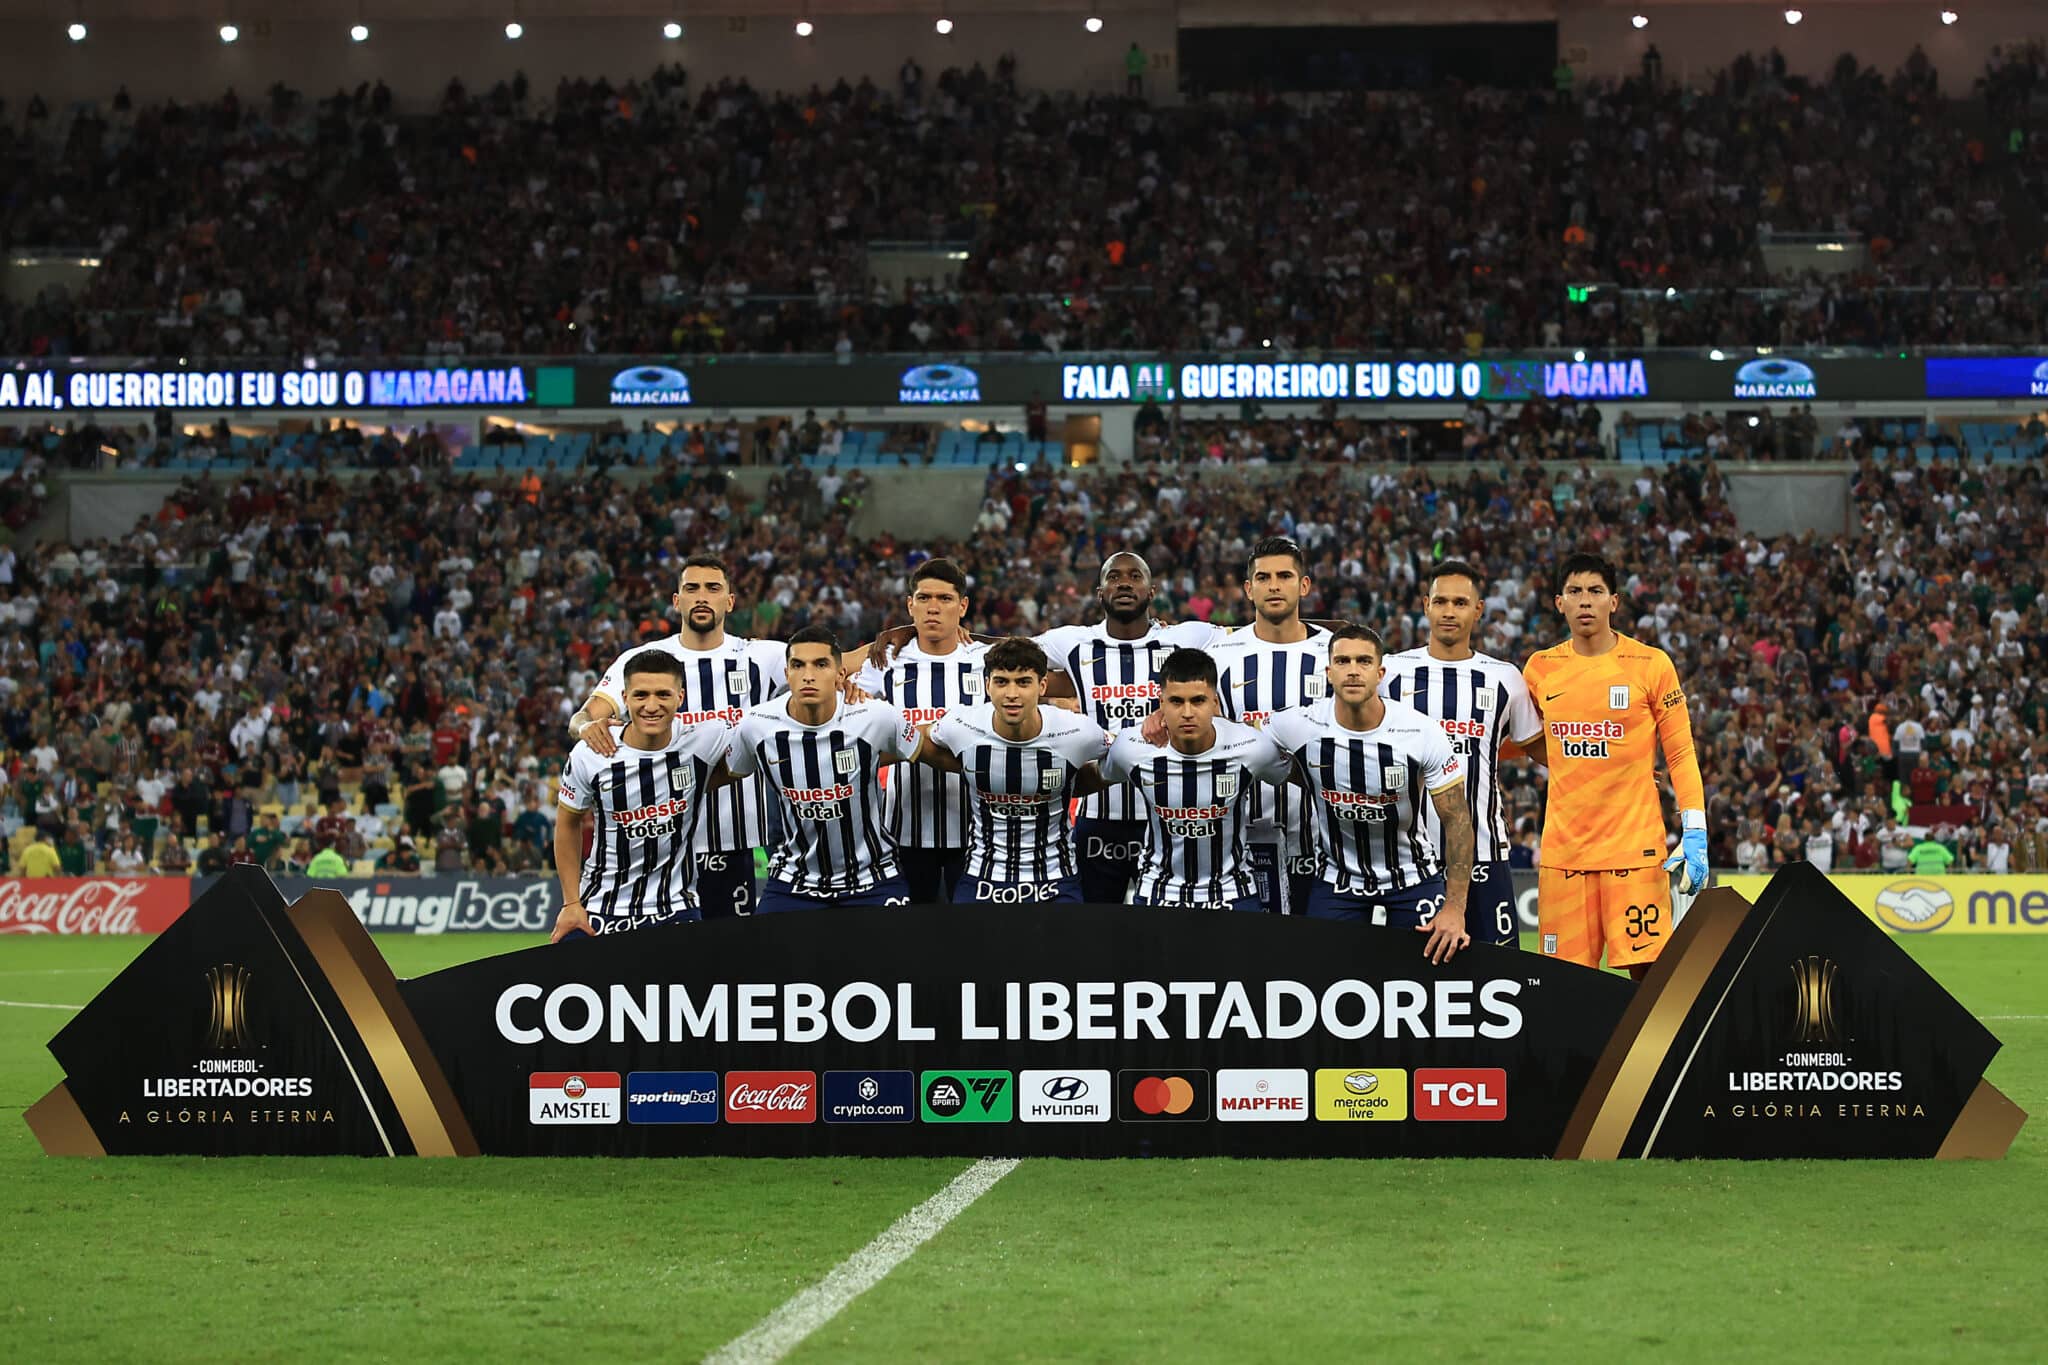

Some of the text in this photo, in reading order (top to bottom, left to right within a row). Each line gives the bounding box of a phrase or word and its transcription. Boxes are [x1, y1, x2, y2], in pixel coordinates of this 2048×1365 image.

[70, 372, 235, 407] GUERREIRO!
[240, 372, 276, 406] EU
[282, 371, 339, 406] SOU
[345, 371, 365, 406] O
[1063, 364, 1131, 399] FALA
[1181, 363, 1349, 399] GUERREIRO!
[1355, 363, 1391, 398] EU
[1397, 363, 1455, 398] SOU
[1461, 363, 1481, 398] O
[902, 709, 946, 726] apue
[1105, 701, 1149, 719] total
[1440, 719, 1485, 737] esta
[1551, 720, 1623, 739] apuesta
[1563, 740, 1608, 758] total
[782, 784, 853, 803] apuesta
[1320, 788, 1400, 805] apuesta
[612, 799, 687, 825] apuesta
[797, 804, 841, 820] total
[990, 803, 1038, 817] total
[1154, 805, 1229, 821] apuesta
[1334, 804, 1386, 822] total
[626, 819, 675, 839] total
[1168, 821, 1215, 838] total
[733, 881, 751, 916] 2
[348, 882, 550, 934] tingbet
[1496, 902, 1513, 935] 6
[1625, 904, 1660, 938] 32
[496, 981, 936, 1044] CONMEBOL
[961, 978, 1523, 1042] LIBERTADORES
[143, 1077, 312, 1097] LIBERTADORES
[1729, 1072, 1902, 1091] LIBERTADORES
[629, 1090, 716, 1106] sportingbet
[729, 1083, 812, 1111] Coca-Cola
[932, 1084, 960, 1099] EA
[1422, 1082, 1498, 1106] TCL
[540, 1102, 610, 1119] AMSTEL
[833, 1104, 904, 1117] crypto.com
[1032, 1104, 1099, 1116] HYUNDAI
[1221, 1097, 1303, 1110] MAPFRE
[1334, 1097, 1389, 1107] mercado
[1703, 1101, 1925, 1118] A GLÓRIA ETERNA
[119, 1108, 335, 1123] A GLÓRIA ETERNA
[1348, 1108, 1374, 1119] livre
